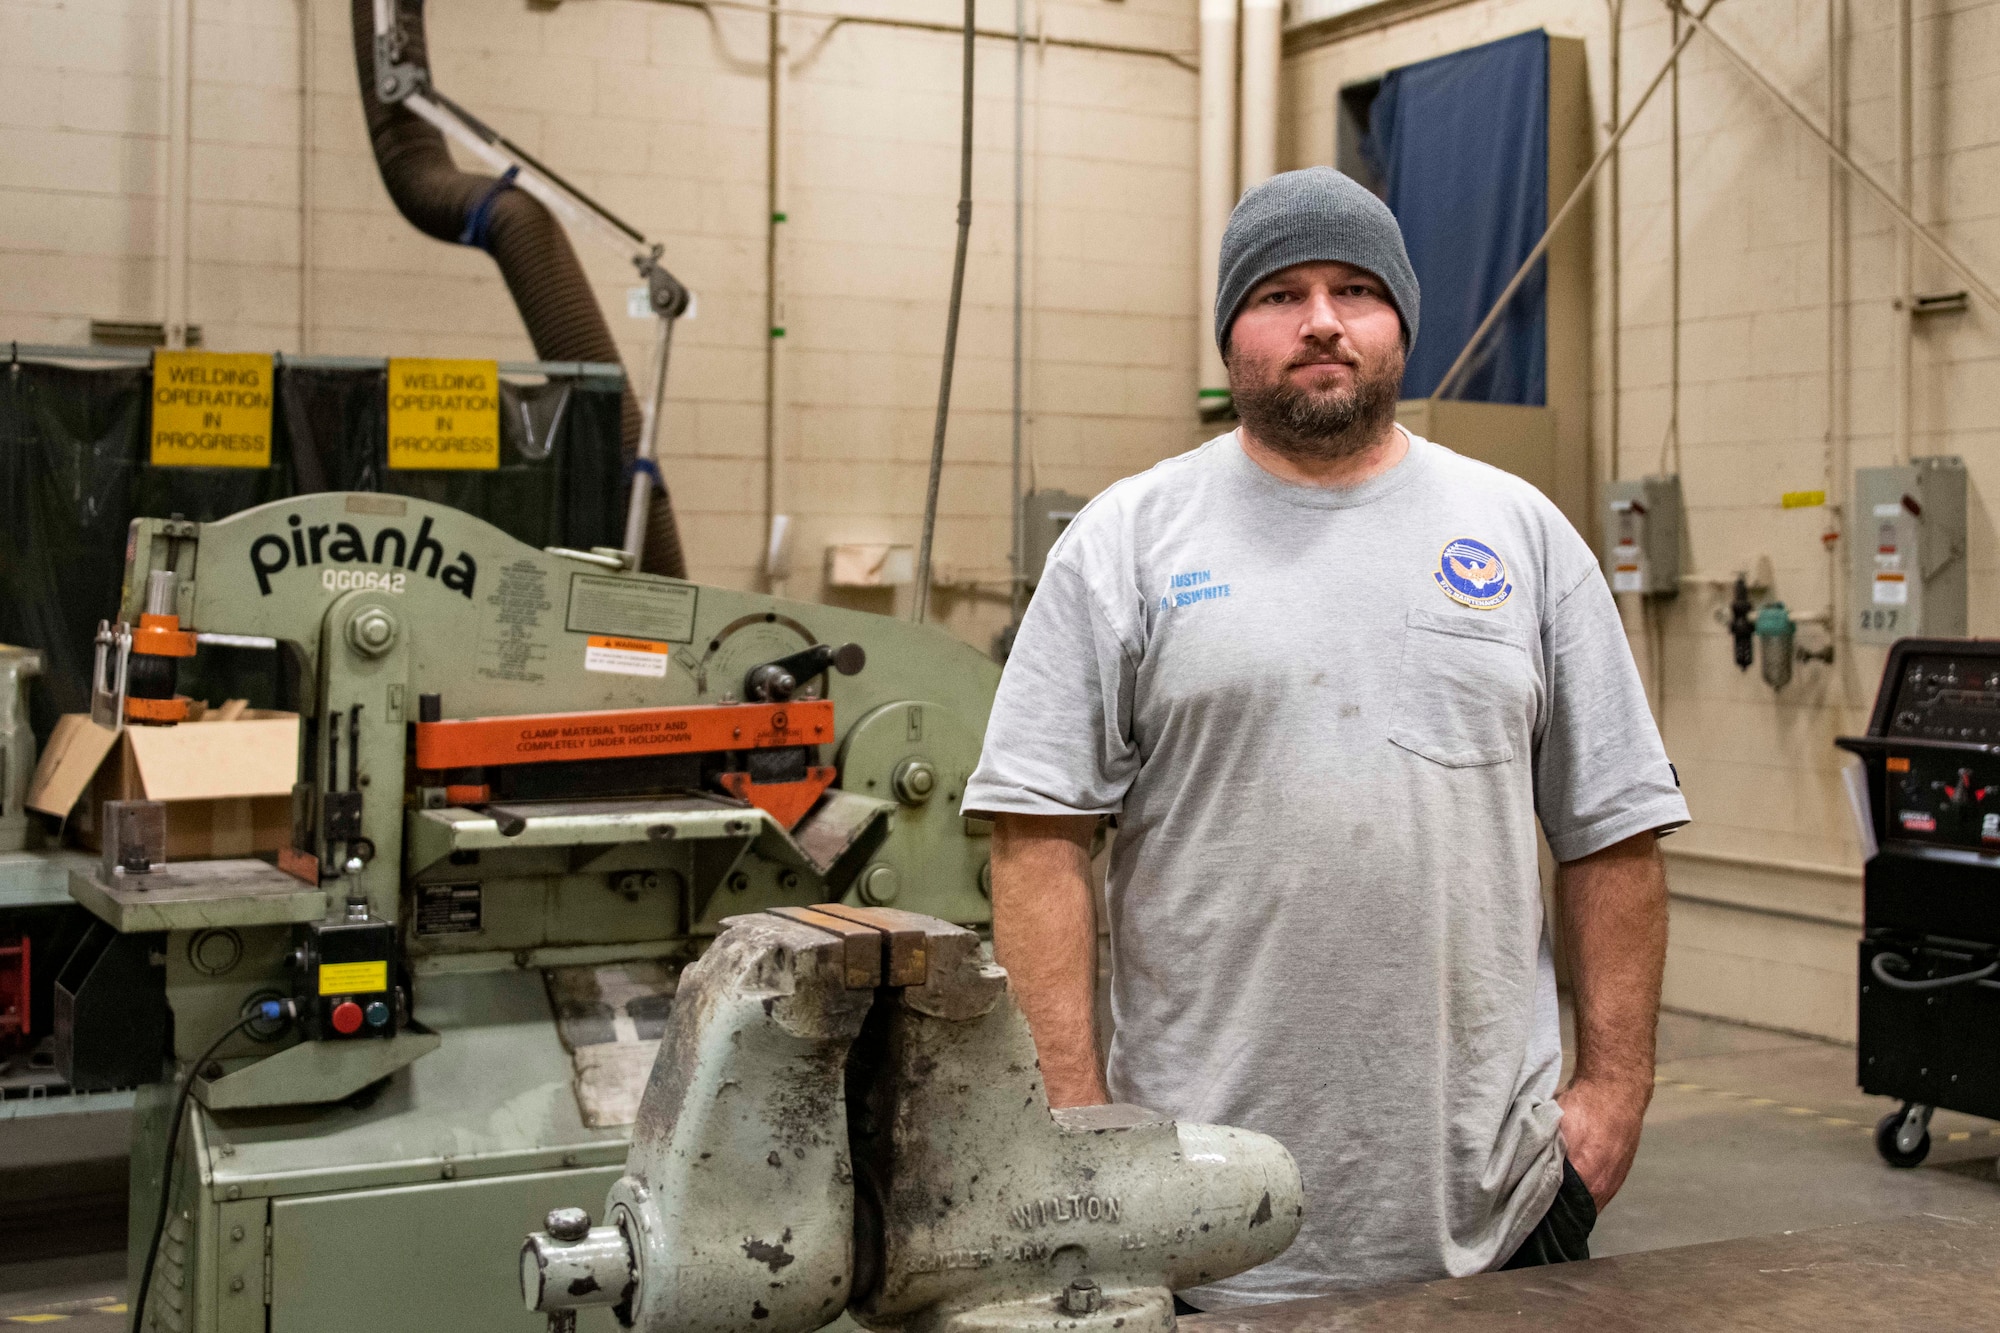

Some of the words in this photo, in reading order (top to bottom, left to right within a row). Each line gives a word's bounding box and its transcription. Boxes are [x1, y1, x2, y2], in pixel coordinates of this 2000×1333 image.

[169, 366, 259, 387] WELDING
[403, 373, 486, 391] WELDING
[156, 387, 270, 408] OPERATION
[392, 394, 497, 412] OPERATION
[203, 411, 222, 428] IN
[435, 416, 453, 431] IN
[156, 431, 266, 452] PROGRESS
[393, 436, 495, 453] PROGRESS
[250, 514, 477, 599] piranha
[1861, 610, 1898, 631] 207
[614, 640, 653, 651] WARNING
[521, 727, 558, 740] CLAMP
[562, 725, 615, 738] MATERIAL
[619, 722, 661, 734] TIGHTLY
[664, 721, 688, 731] AND
[516, 738, 584, 752] COMPLETELY
[590, 737, 625, 748] UNDER
[629, 733, 692, 745] HOLDDOWN
[1011, 1194, 1121, 1231] WILTON
